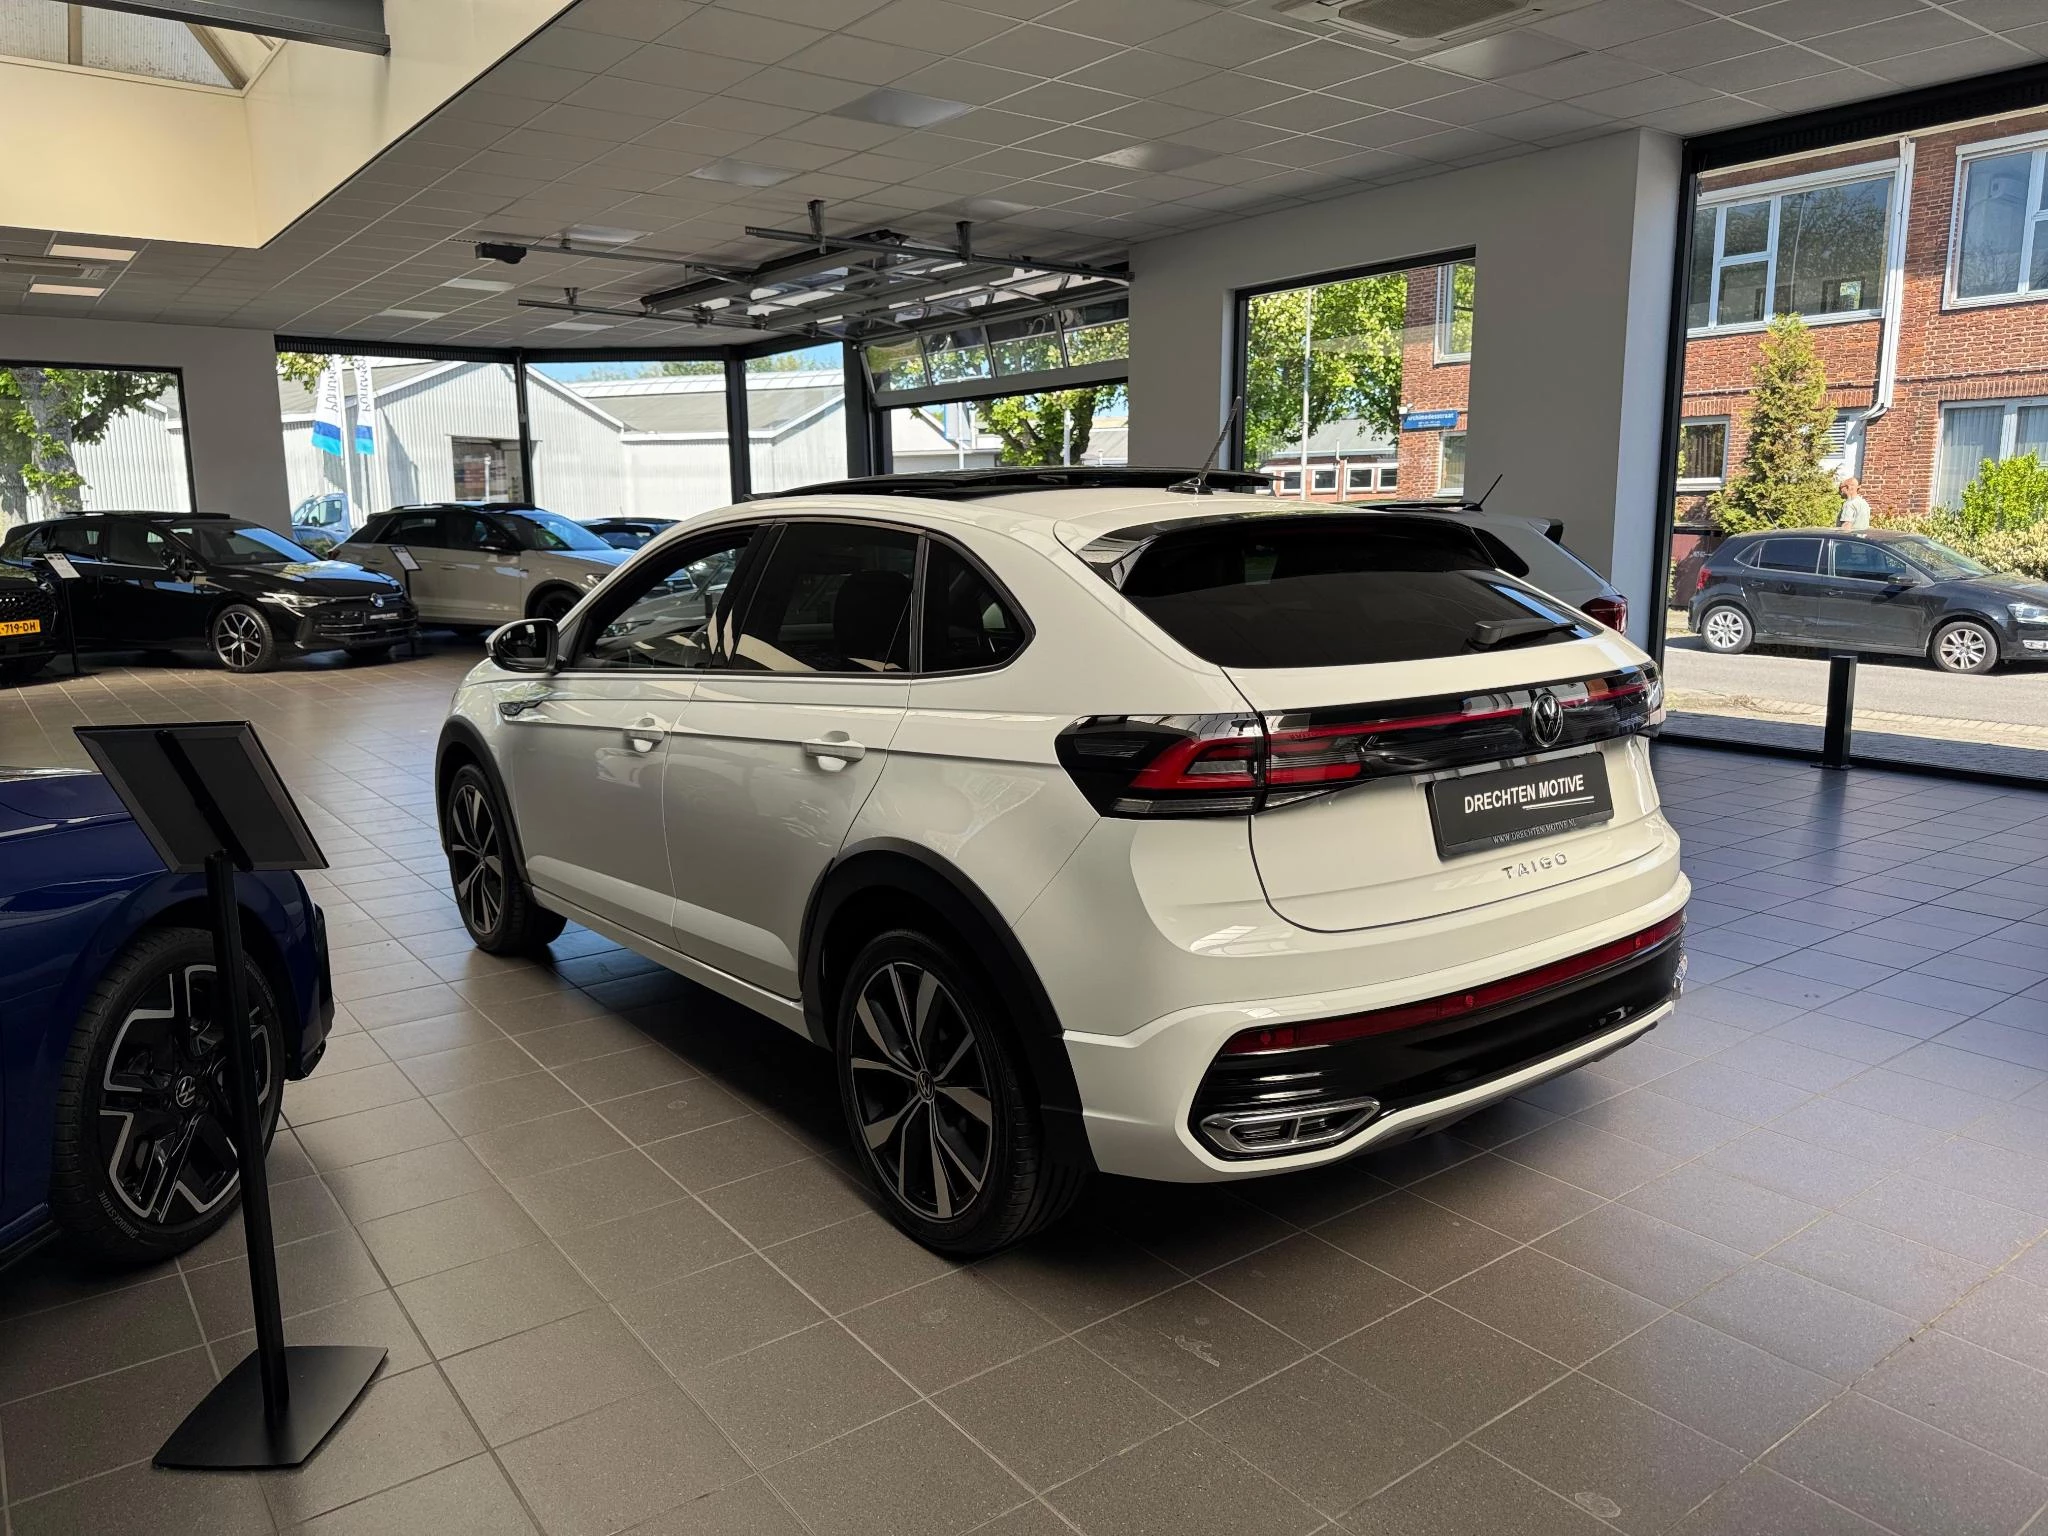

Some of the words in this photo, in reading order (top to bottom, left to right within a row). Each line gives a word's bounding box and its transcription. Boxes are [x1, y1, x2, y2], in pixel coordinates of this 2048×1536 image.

[0, 621, 36, 634] -719-DH
[1464, 783, 1536, 814] DRECHTEN
[1538, 774, 1585, 799] MOTIVE
[1501, 852, 1567, 880] TAIGO
